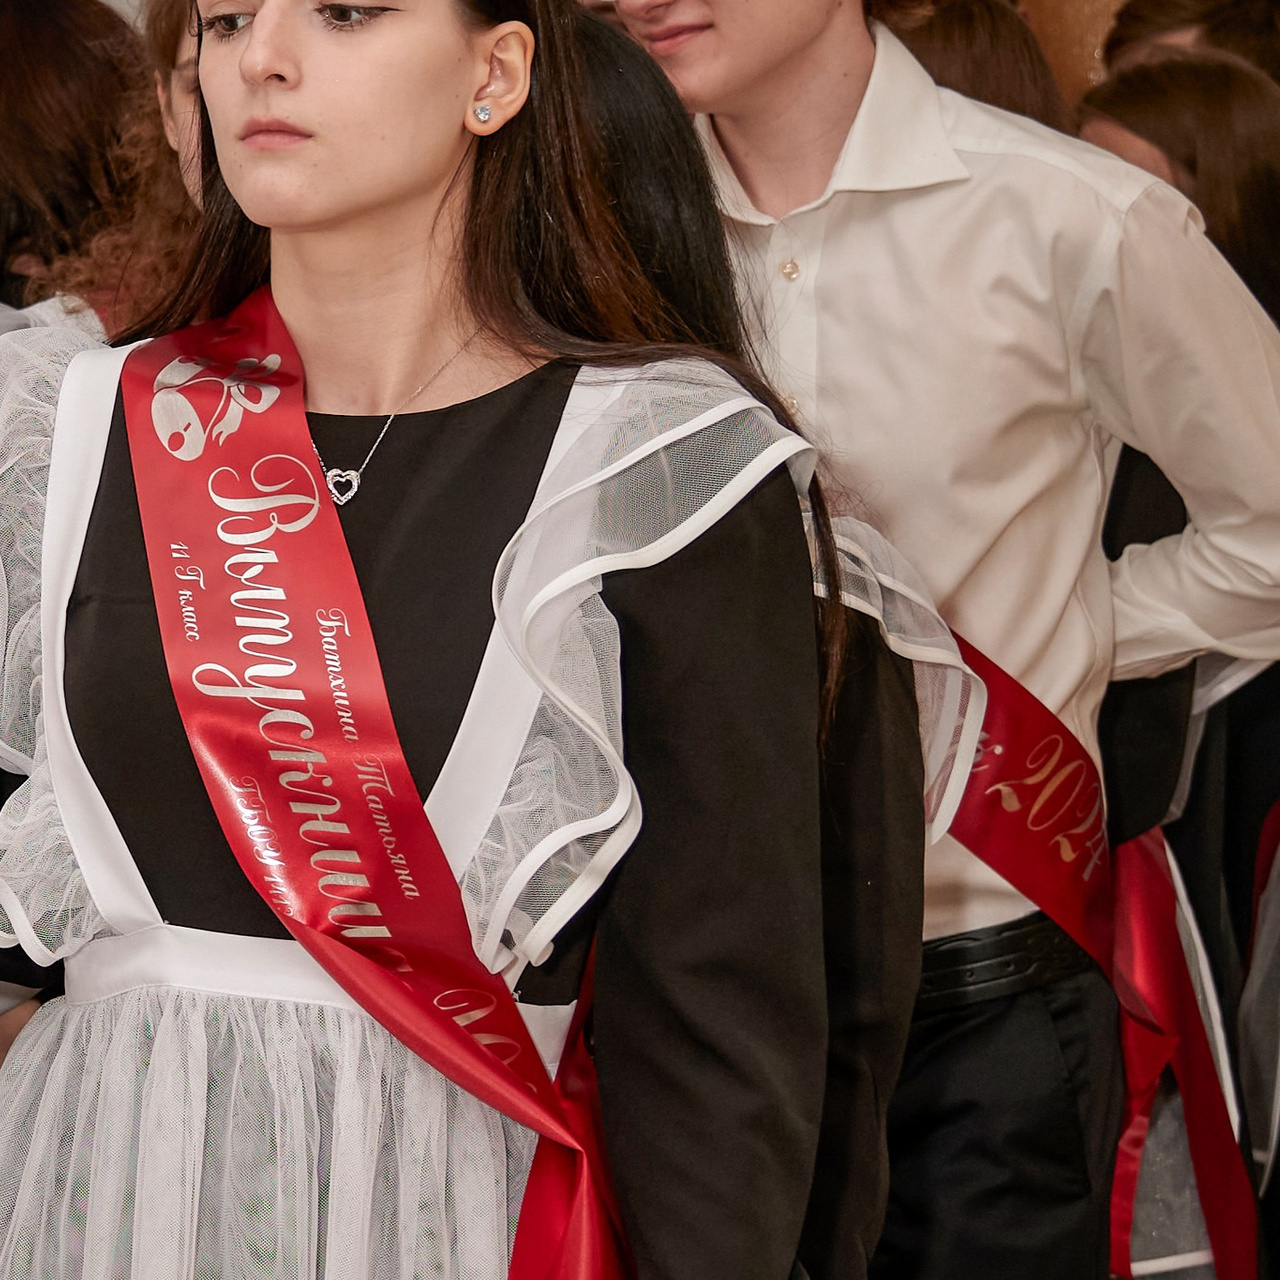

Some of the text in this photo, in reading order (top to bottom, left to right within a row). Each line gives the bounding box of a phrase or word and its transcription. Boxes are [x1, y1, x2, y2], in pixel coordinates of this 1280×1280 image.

[170, 541, 206, 642] 11 Г класс
[315, 607, 421, 900] Батхина Татьяна
[228, 775, 286, 866] ГБОУ
